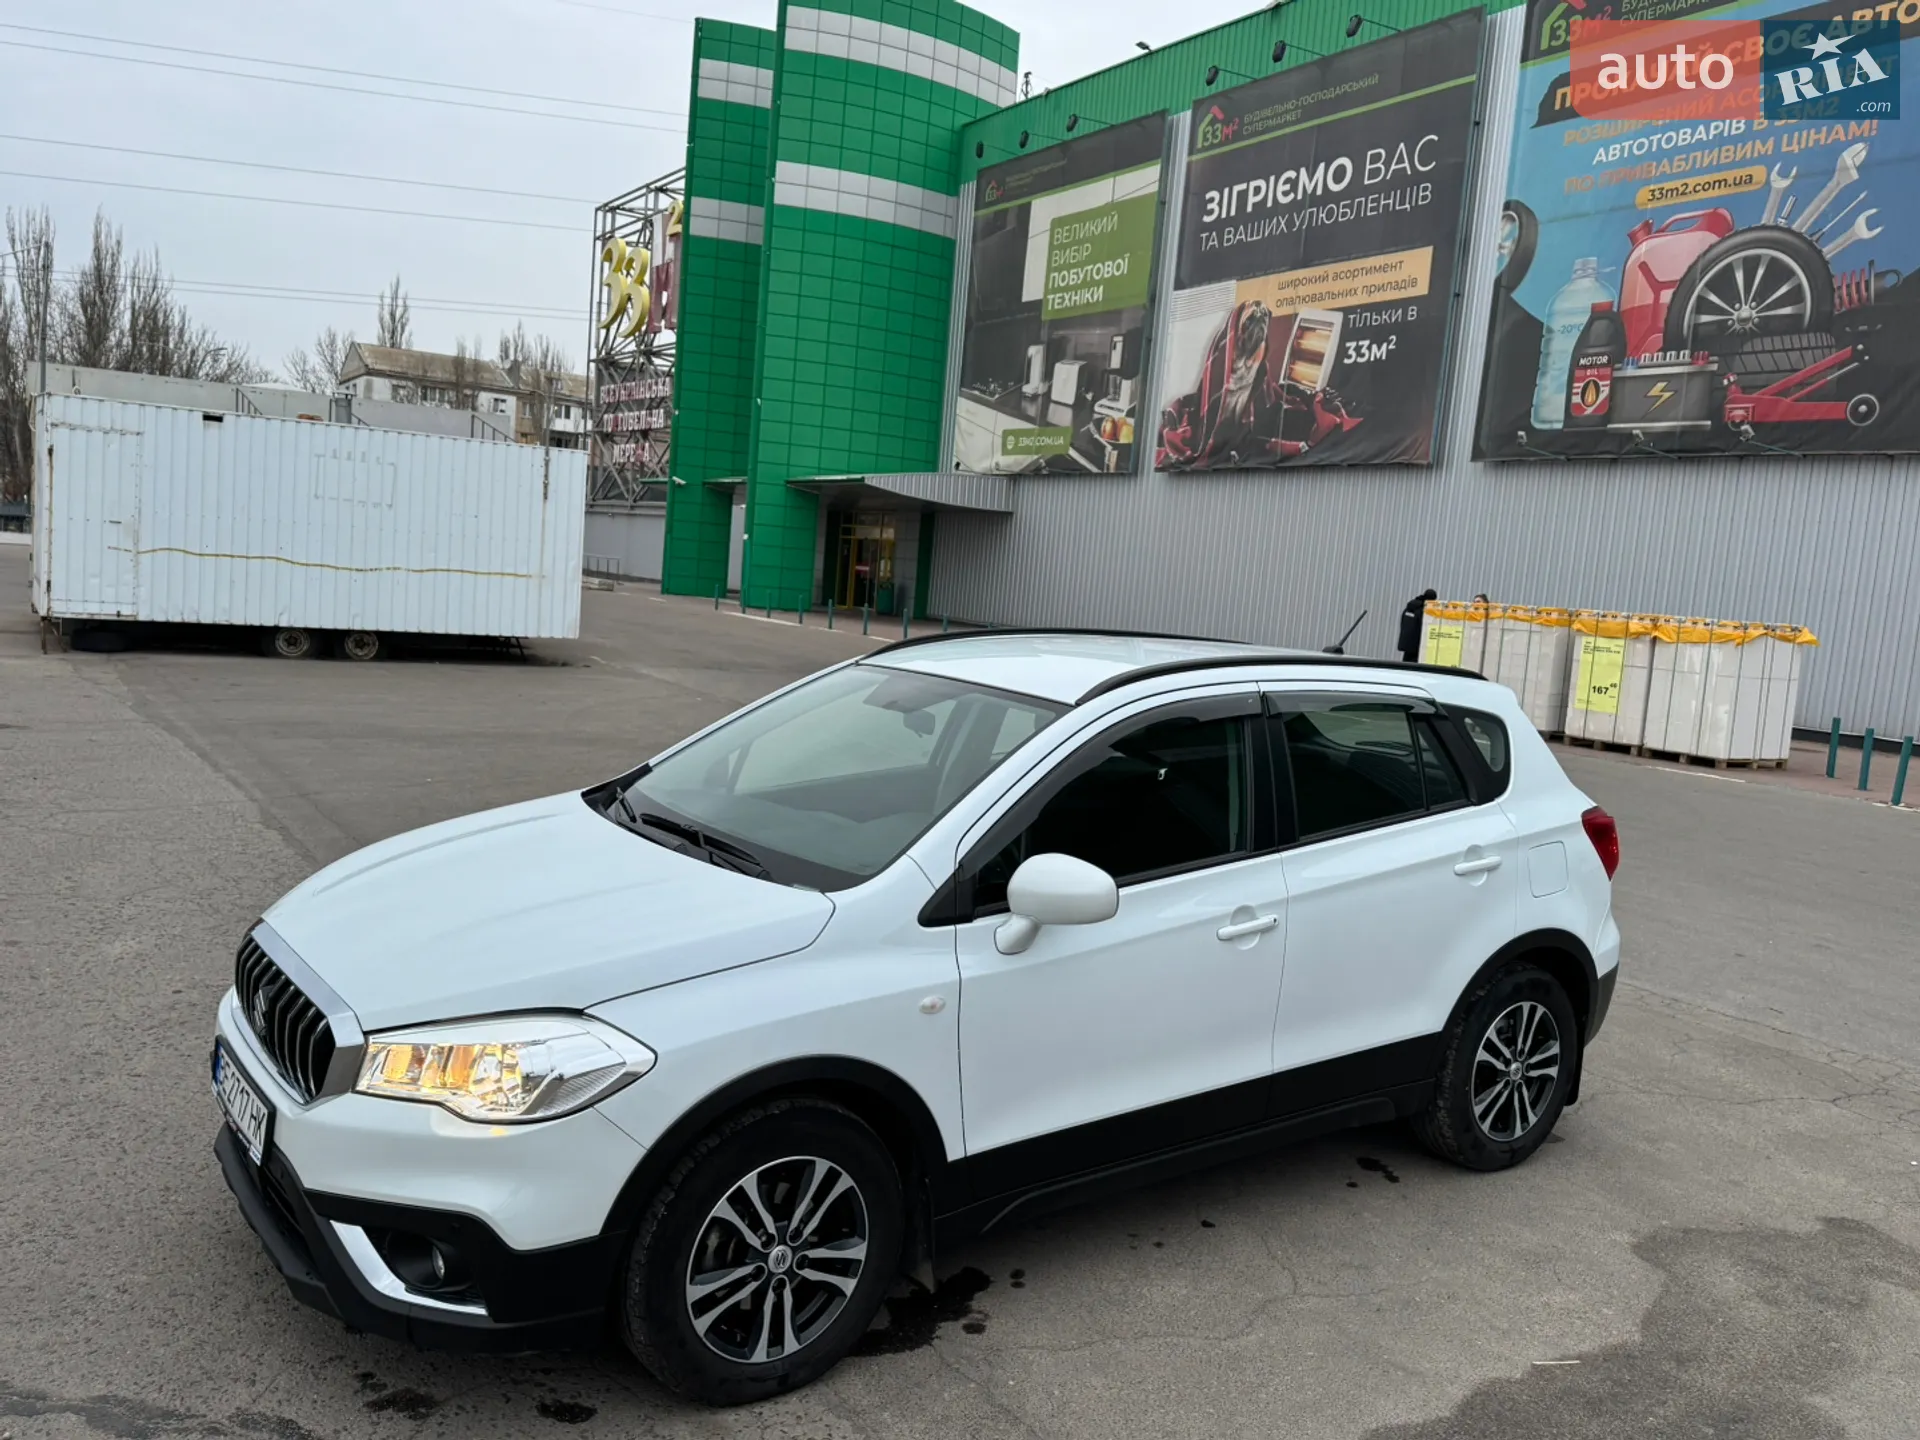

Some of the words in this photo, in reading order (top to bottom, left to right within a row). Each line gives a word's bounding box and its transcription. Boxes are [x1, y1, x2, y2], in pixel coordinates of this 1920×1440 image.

[1724, 22, 1815, 66] СВОЄ
[1243, 74, 1380, 123] БУДІВЕЛЬНО-ГОСПОДАРСЬКИЙ
[1242, 109, 1302, 135] СУПЕРМАРКЕТ
[1564, 174, 1595, 195] ПО
[1598, 136, 1775, 189] ПРИВАБЛИВИМ
[1781, 118, 1880, 153] ЦІНАМ!
[1592, 116, 1746, 165] АВТОТОВАРІВ
[1202, 156, 1353, 223] ЗІГРІЄМО
[1364, 134, 1439, 185] ВАС
[1647, 173, 1754, 202] 33m2.com.ua
[1053, 211, 1119, 245] ВЕЛИКИЙ
[1200, 231, 1219, 252] ТА
[1223, 213, 1289, 247] ВАШИХ
[1292, 182, 1432, 232] УЛЮБЛЕНЦІВ
[1048, 253, 1131, 289] ПОБУТОВОЇ
[1051, 243, 1092, 267] ВИБІР
[1275, 286, 1359, 309] опалювальних
[1361, 275, 1418, 297] приладів
[1277, 270, 1329, 291] широкий
[1332, 260, 1404, 282] асортимент
[1046, 285, 1104, 310] ТЕХНІКИ
[1579, 355, 1609, 367] MOTOR
[1592, 685, 1609, 695] 167
